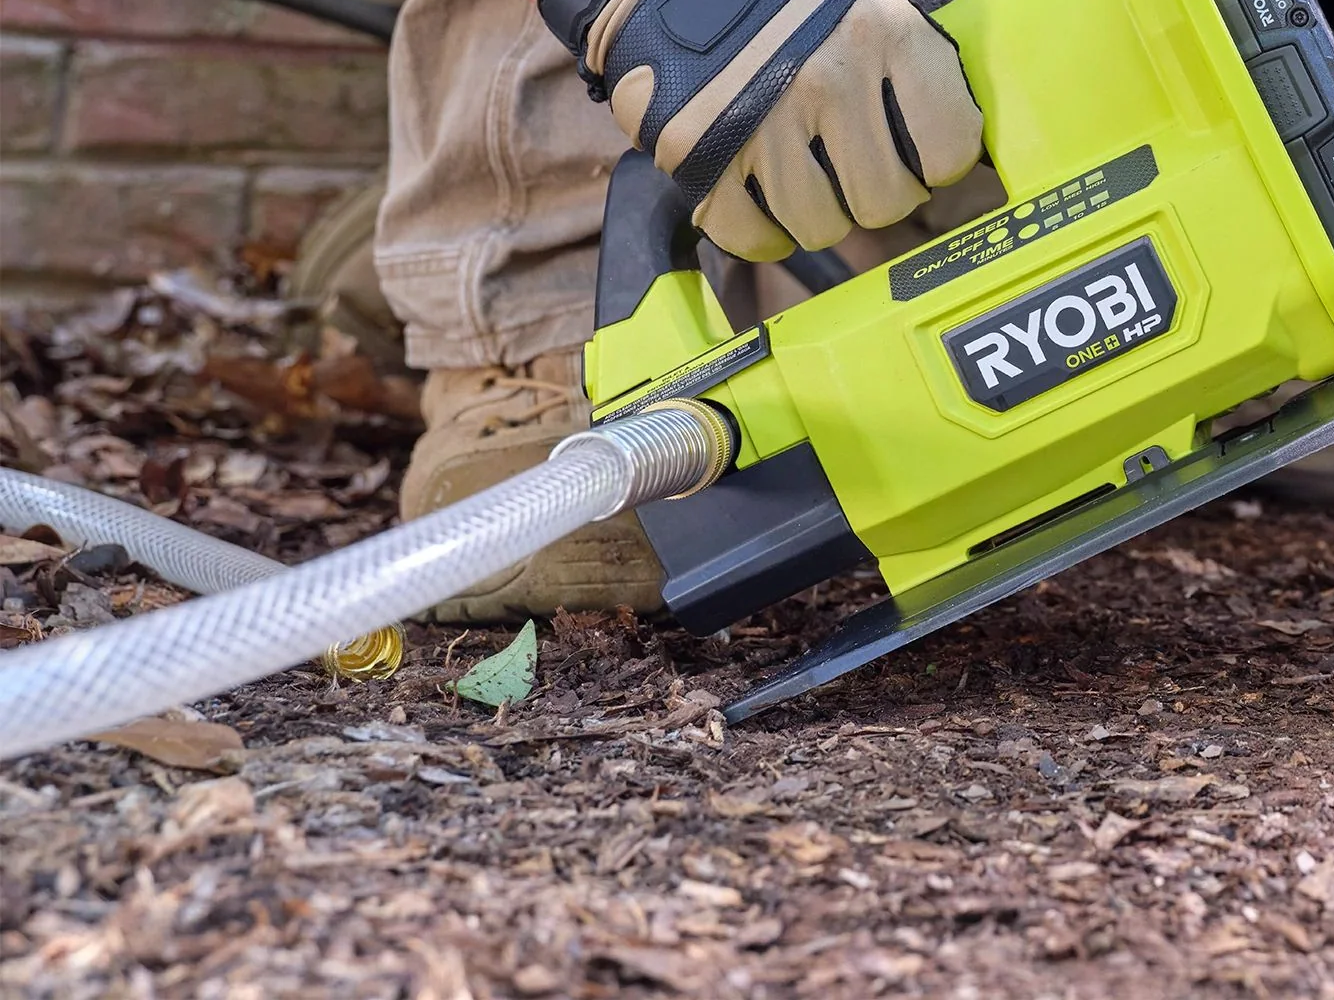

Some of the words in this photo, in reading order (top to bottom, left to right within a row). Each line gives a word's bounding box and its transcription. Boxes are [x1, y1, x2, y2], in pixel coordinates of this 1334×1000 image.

[948, 216, 1010, 251] SPEED
[1041, 201, 1060, 213] LOW
[1064, 190, 1083, 202] MED
[1085, 179, 1107, 191] HIGH
[968, 236, 1015, 264] TIME
[1073, 212, 1084, 220] 10
[913, 239, 984, 279] ON/OFF
[977, 244, 1014, 266] MINUTES
[964, 262, 1157, 390] RYOBI
[1124, 313, 1162, 342] HP
